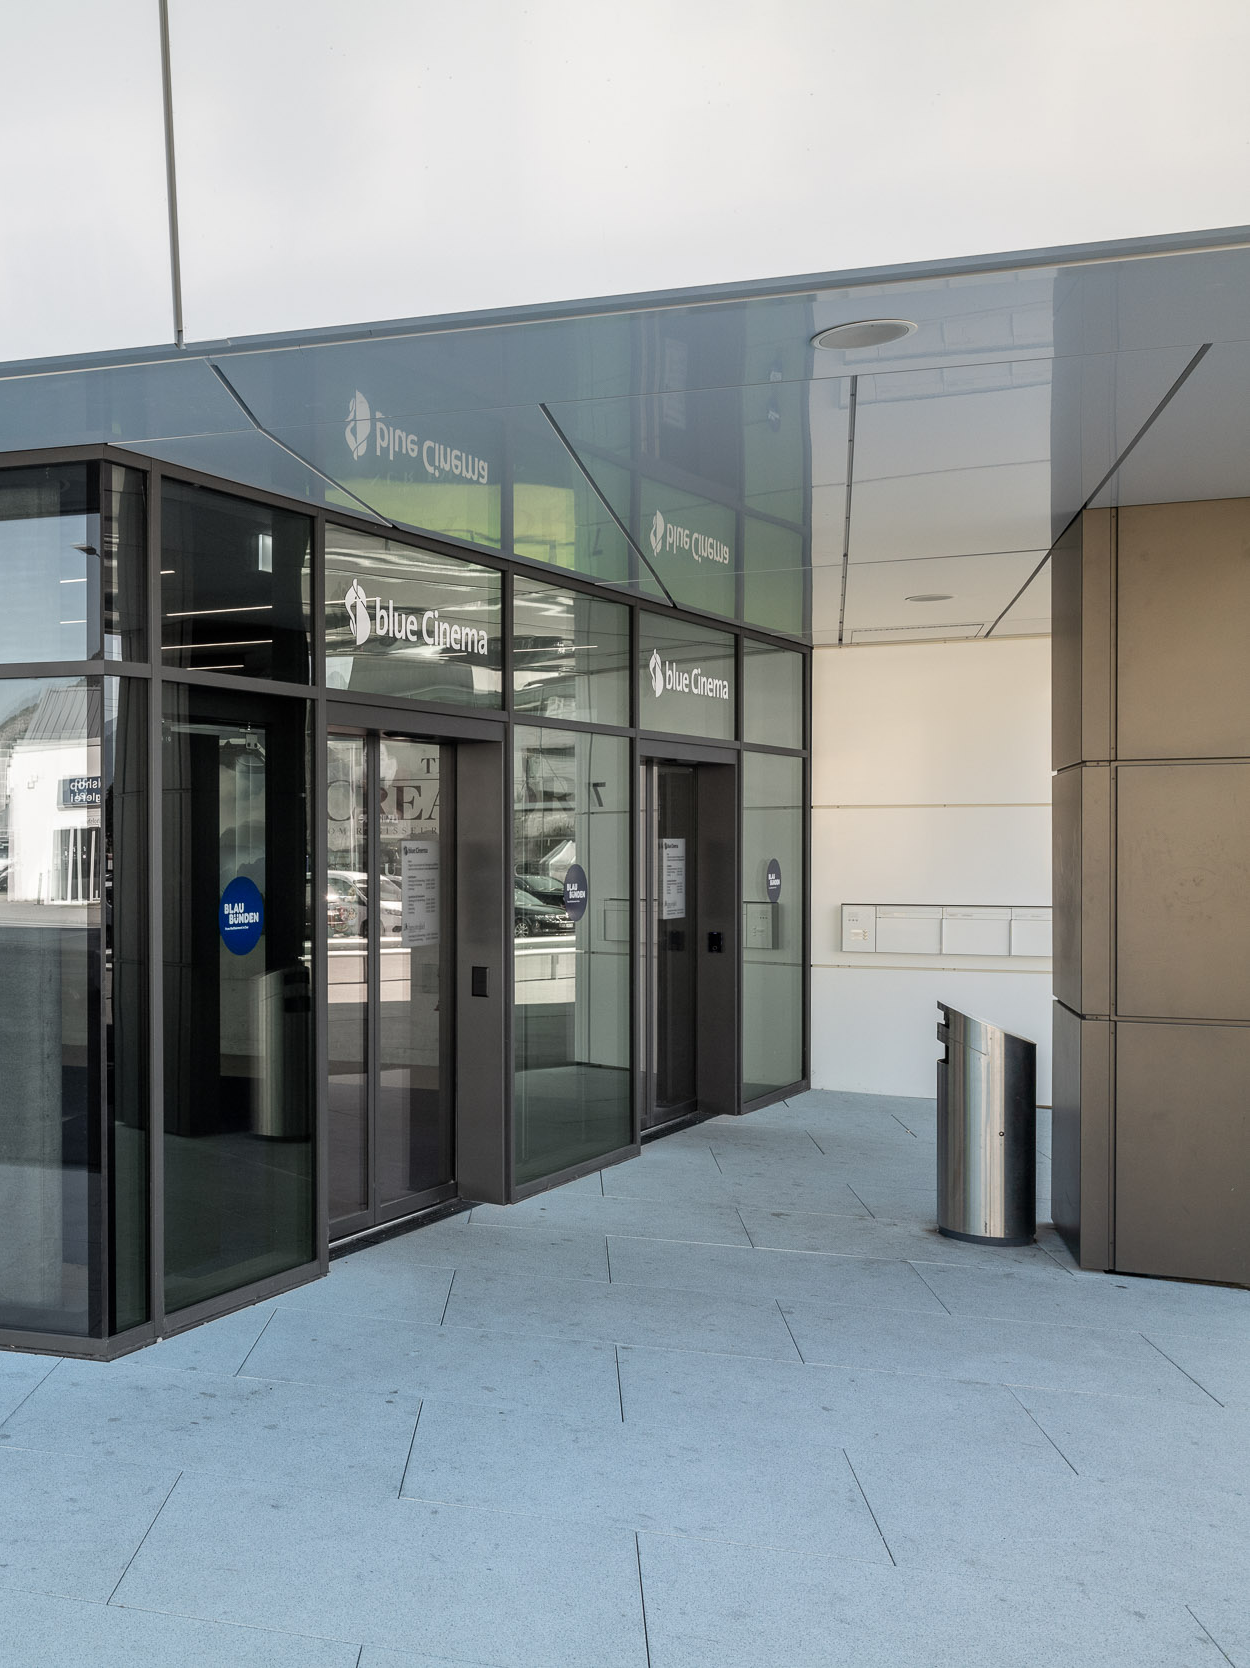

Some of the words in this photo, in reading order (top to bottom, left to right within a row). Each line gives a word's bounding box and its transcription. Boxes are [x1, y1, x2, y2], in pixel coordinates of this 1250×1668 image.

[375, 596, 418, 642] blue
[422, 610, 488, 655] Cinema
[665, 660, 690, 693] blue
[691, 667, 729, 700] Cinema
[224, 902, 245, 914] BLAU
[228, 912, 259, 924] BÜNDEN
